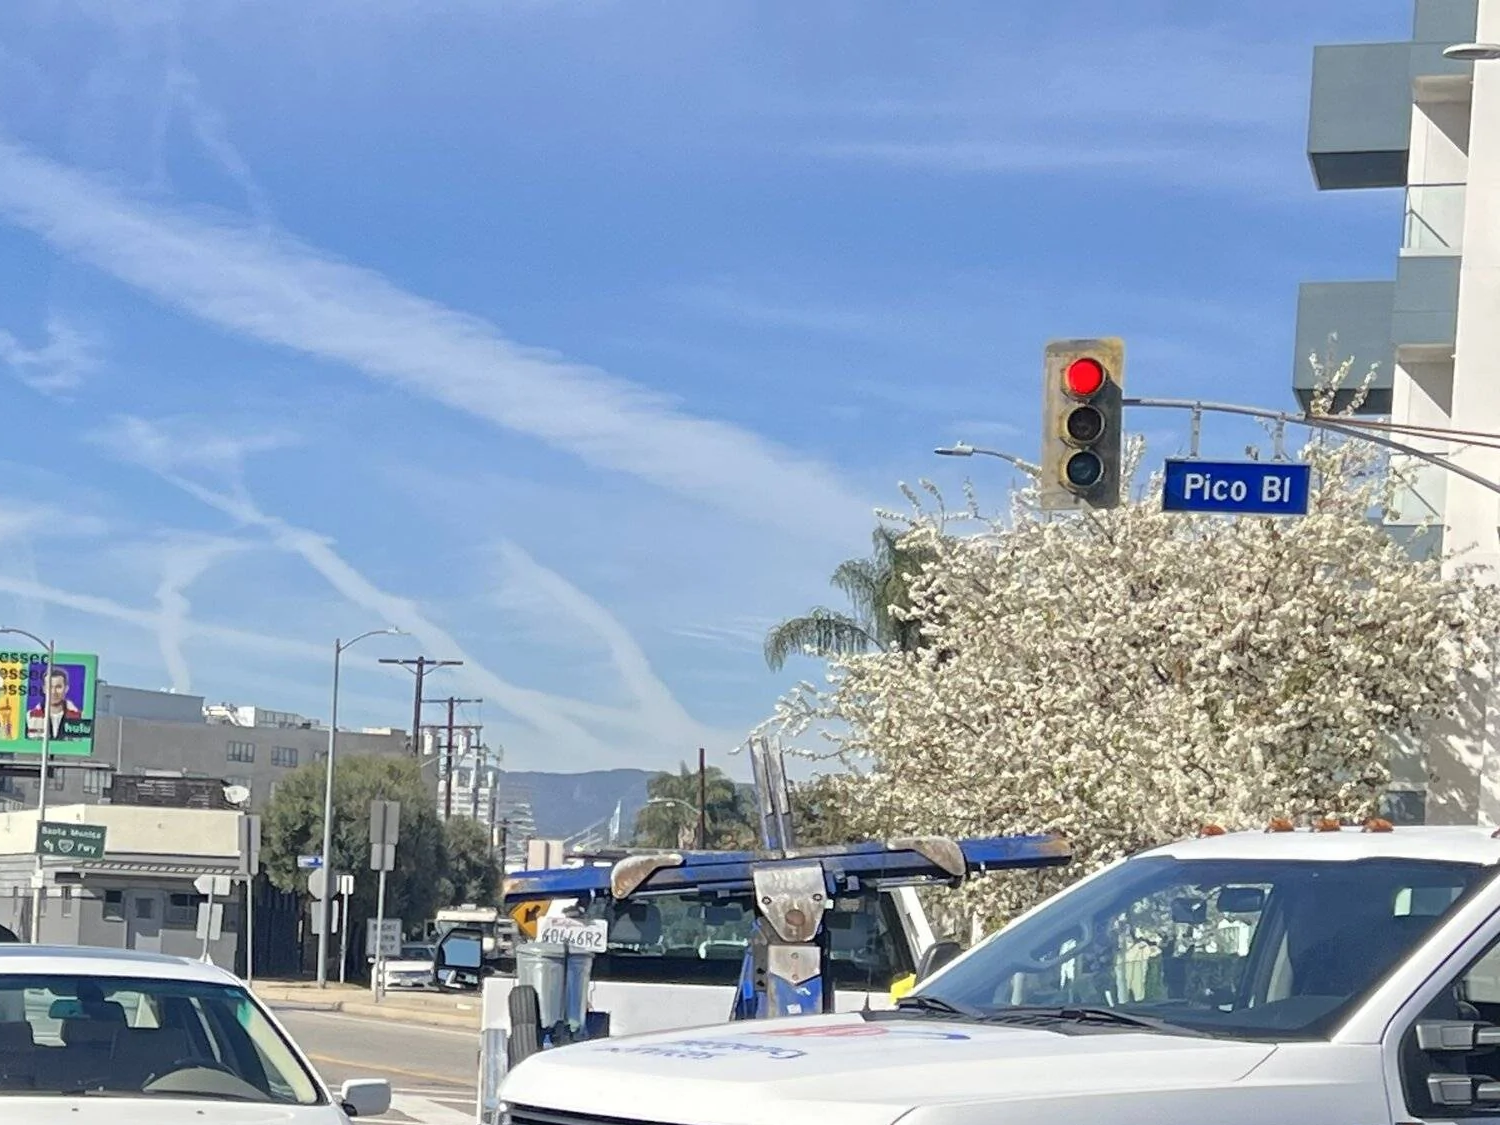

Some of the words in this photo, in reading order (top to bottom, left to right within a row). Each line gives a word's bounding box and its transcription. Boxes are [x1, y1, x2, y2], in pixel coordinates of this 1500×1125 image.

[1184, 473, 1247, 502] Pico
[1262, 475, 1291, 503] Bl
[64, 721, 91, 735] hulu
